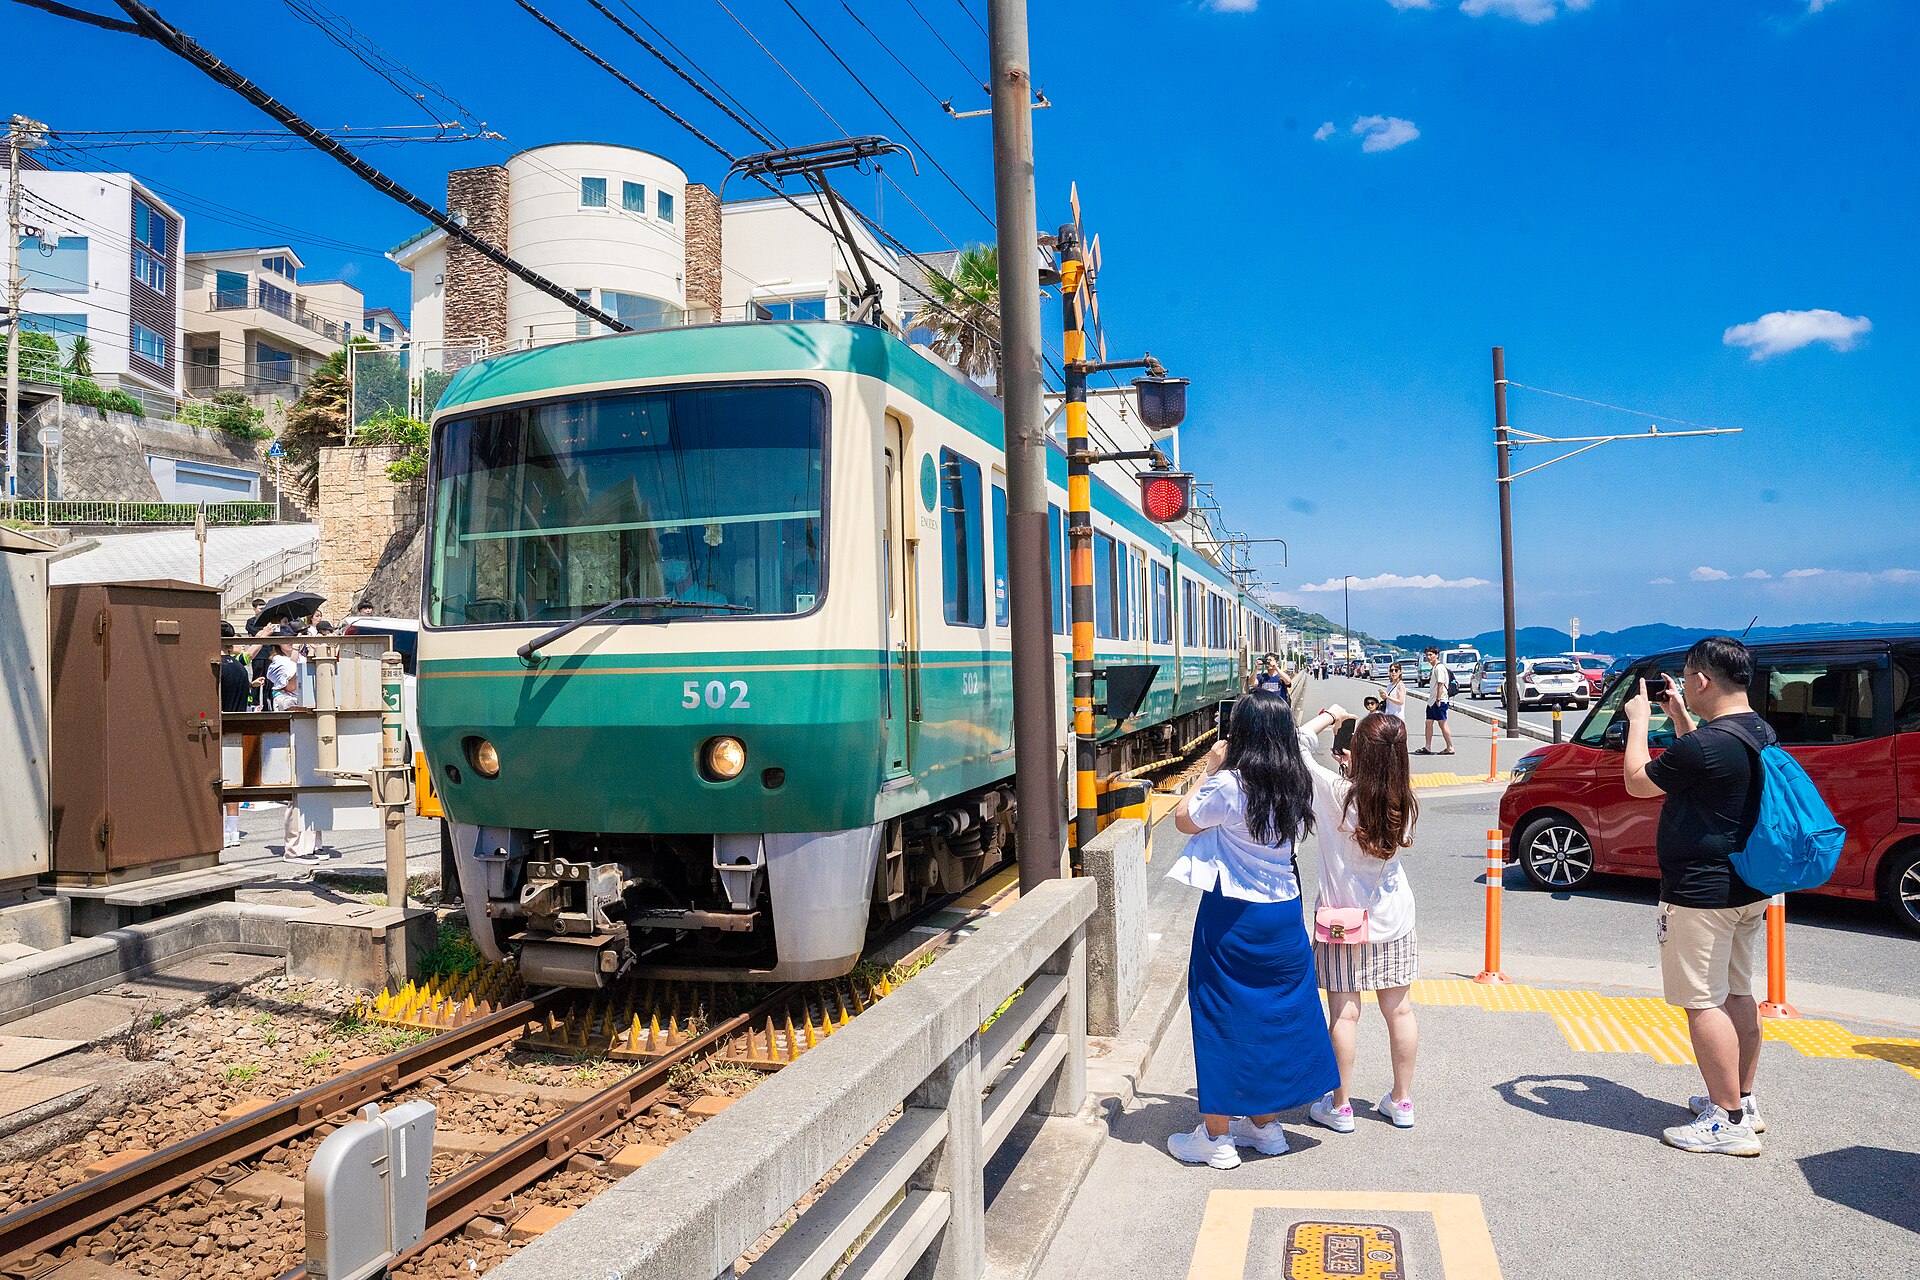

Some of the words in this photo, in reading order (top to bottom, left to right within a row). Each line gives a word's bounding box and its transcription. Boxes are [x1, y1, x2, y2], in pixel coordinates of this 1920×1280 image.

[920, 515, 939, 531] ENODEN
[681, 680, 751, 709] 502
[962, 671, 979, 696] 502
[1330, 1238, 1358, 1272] 消火栓
